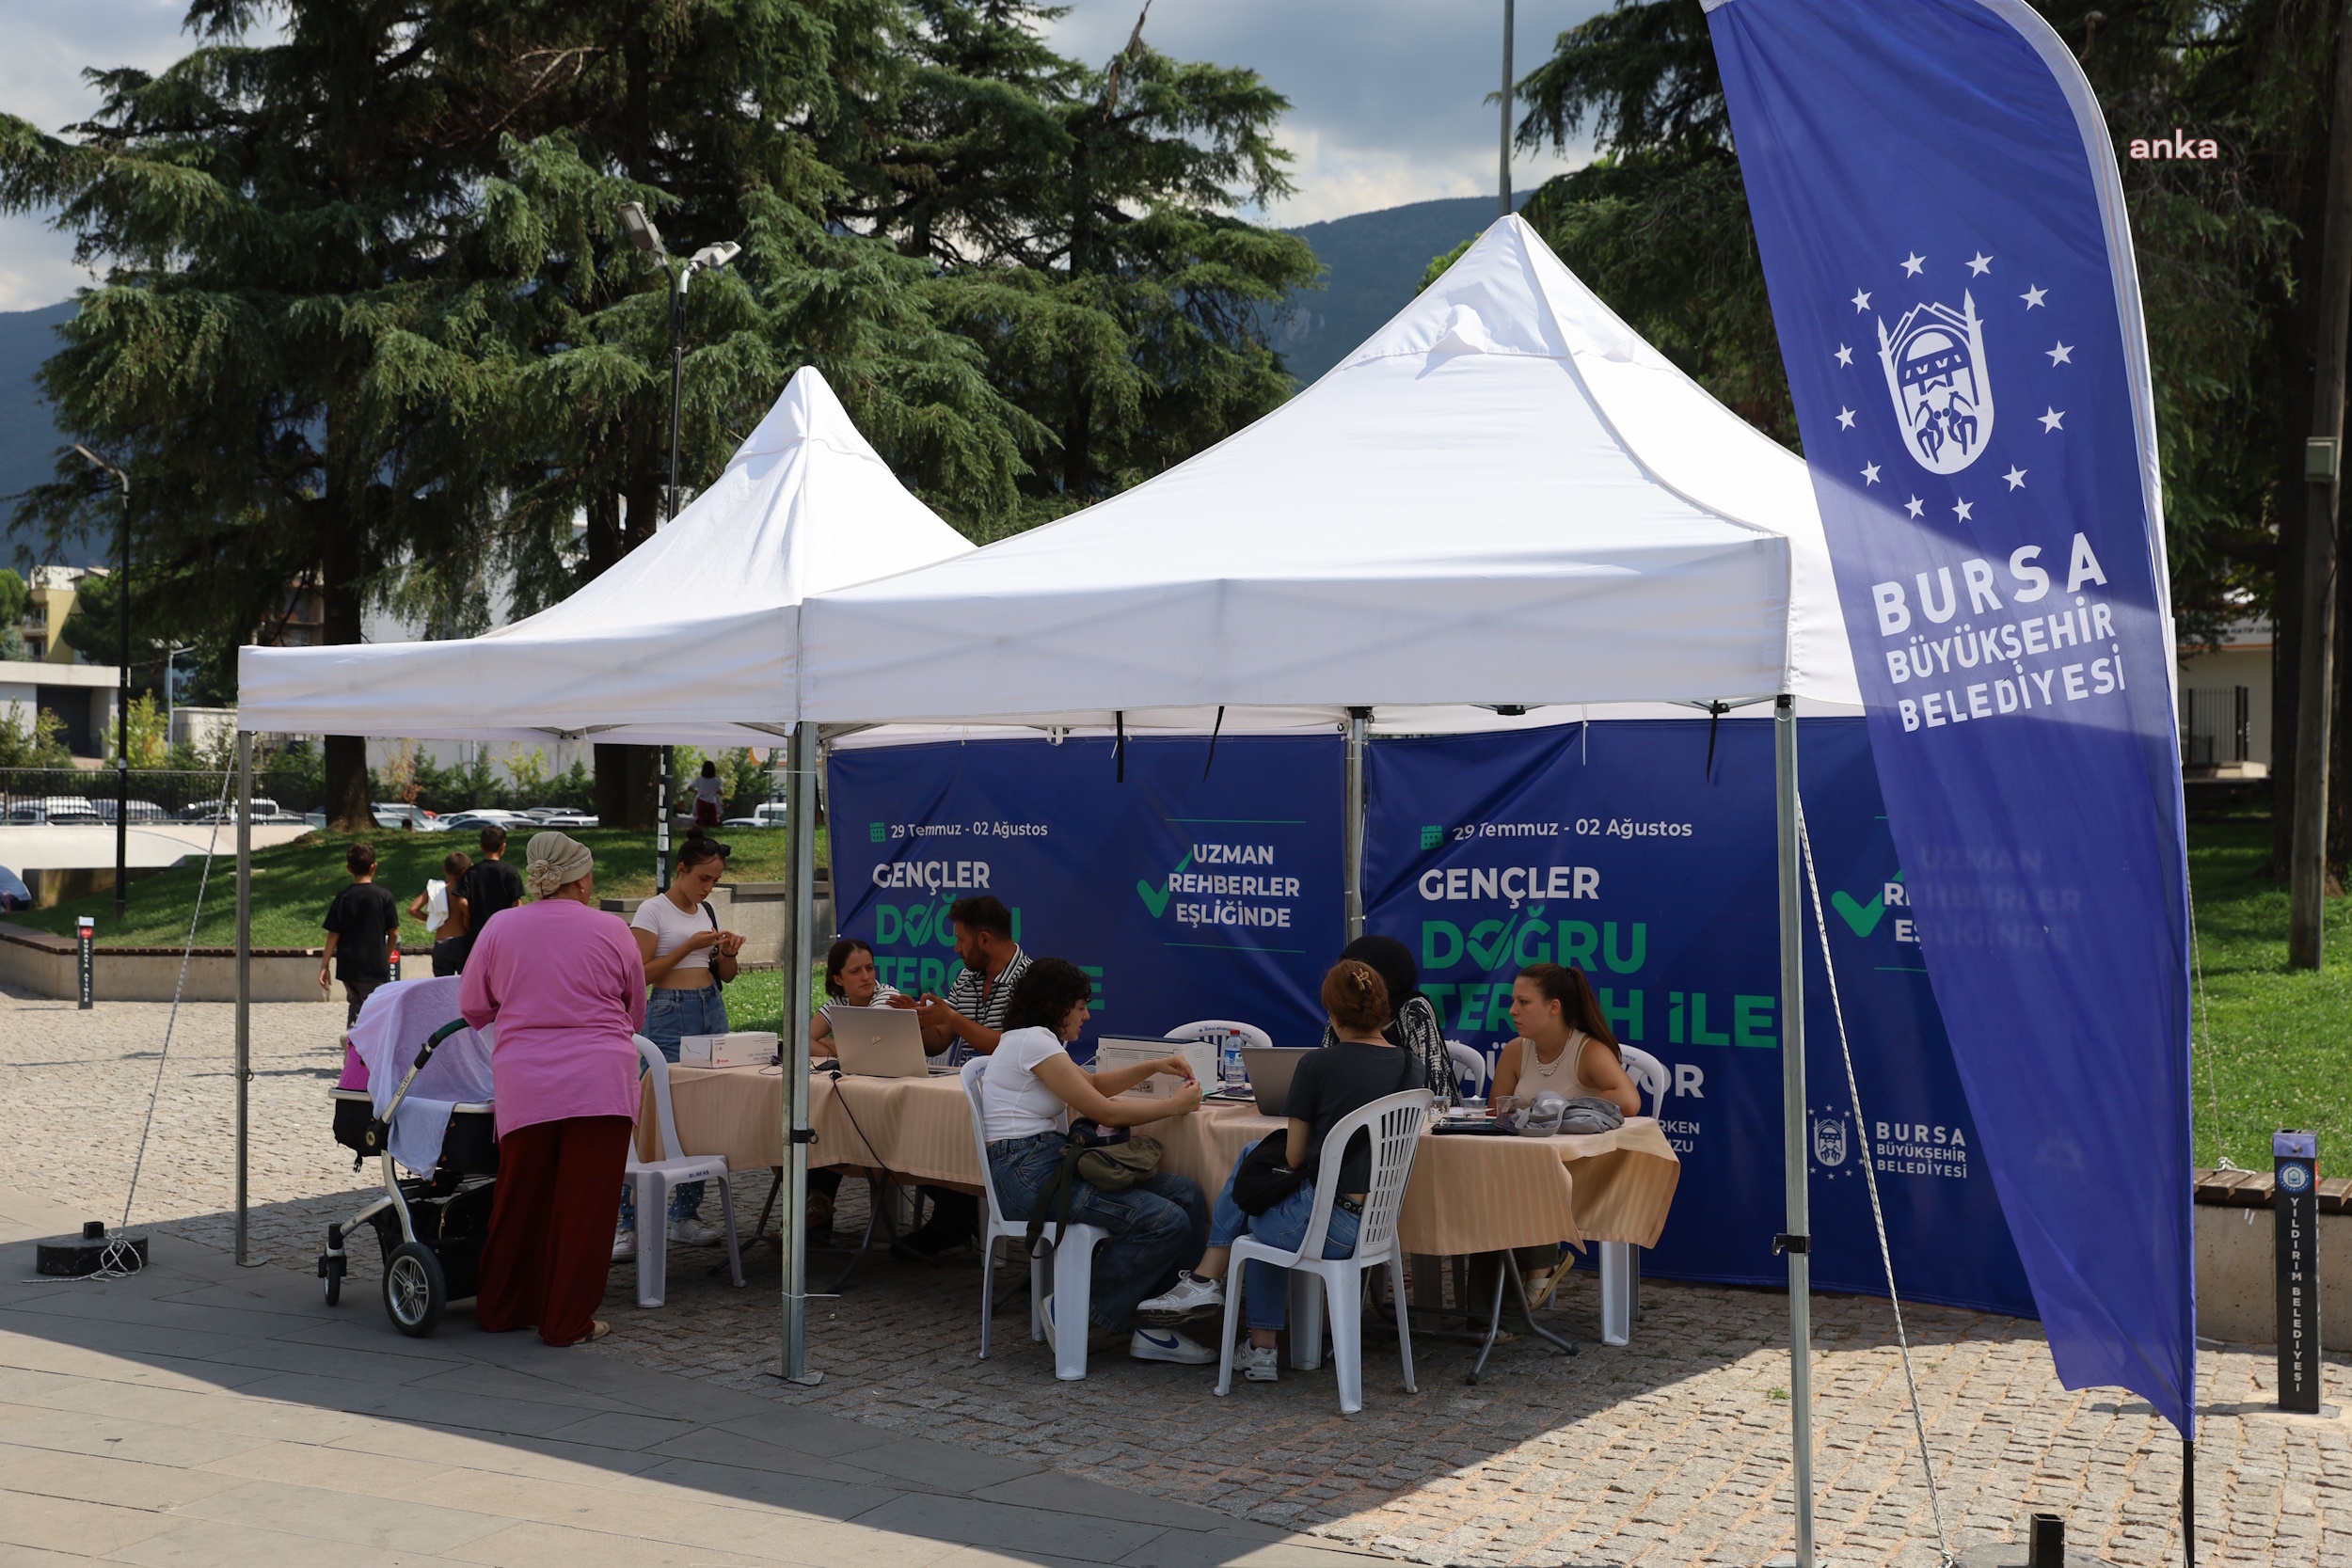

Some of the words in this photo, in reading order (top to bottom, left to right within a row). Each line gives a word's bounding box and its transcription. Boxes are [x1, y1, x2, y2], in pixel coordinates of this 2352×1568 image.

[1871, 531, 2107, 637] BURSA
[1885, 595, 2116, 685] BÜYÜKŞEHİR
[1898, 643, 2125, 733] BELEDİYESİ
[890, 824, 905, 839] 29
[907, 823, 961, 837] Temmuz
[973, 821, 989, 835] 02
[992, 820, 1048, 839] Ağustos
[1453, 824, 1475, 841] 29
[1478, 821, 1559, 838] Temmuz
[1575, 818, 1600, 835] 02
[1605, 817, 1692, 840] Ağustos
[1193, 844, 1274, 865] UZMAN
[872, 860, 991, 896] GENÇLER
[1168, 873, 1300, 897] REHBERLER
[1418, 865, 1600, 910] GENÇLER
[876, 893, 1022, 947] DOĞ
[1176, 898, 1291, 928] EŞLİĞİNDE
[1422, 905, 1647, 974] DOĞRU
[1419, 983, 1645, 1041] TERH
[1669, 991, 1777, 1049] İLE
[1876, 1121, 1966, 1147] BURSA
[1876, 1141, 1966, 1163] BÜYÜKŞEHİR
[1877, 1159, 1967, 1179] BELEDİYESİ
[2290, 1197, 2302, 1281] YILDIRIM
